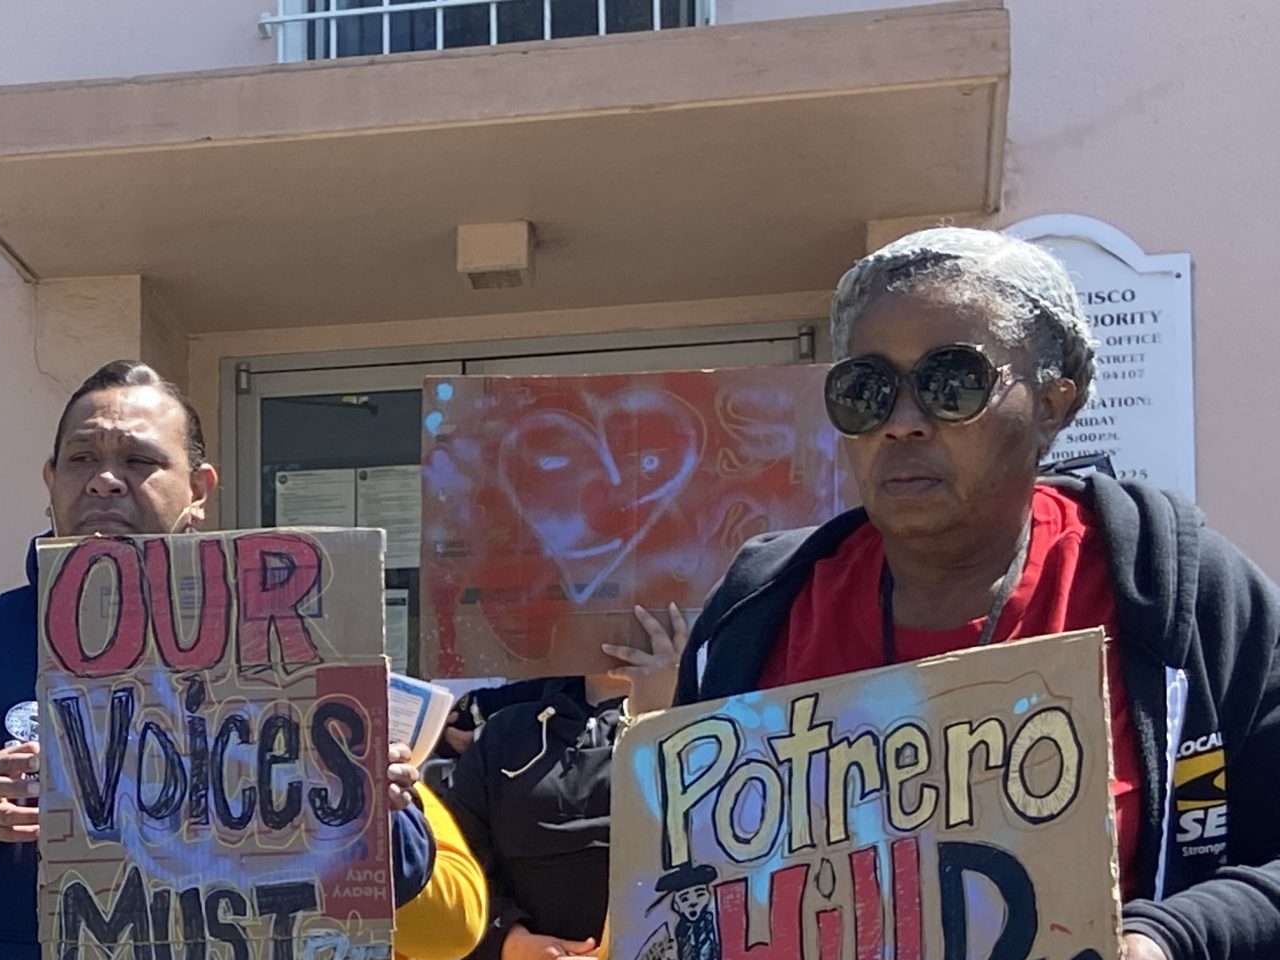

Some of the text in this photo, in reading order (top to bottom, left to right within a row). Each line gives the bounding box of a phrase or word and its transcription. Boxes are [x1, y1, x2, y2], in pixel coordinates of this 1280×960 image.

[1106, 332, 1162, 347] OFFICE
[1097, 352, 1147, 366] STREET
[1102, 368, 1145, 382] 94107
[1068, 416, 1117, 428] RIDAY
[45, 535, 326, 678] OUR
[52, 676, 368, 831] Voices
[661, 694, 1083, 870] Potrero
[346, 868, 386, 886] Duty
[333, 888, 386, 903] Heavy
